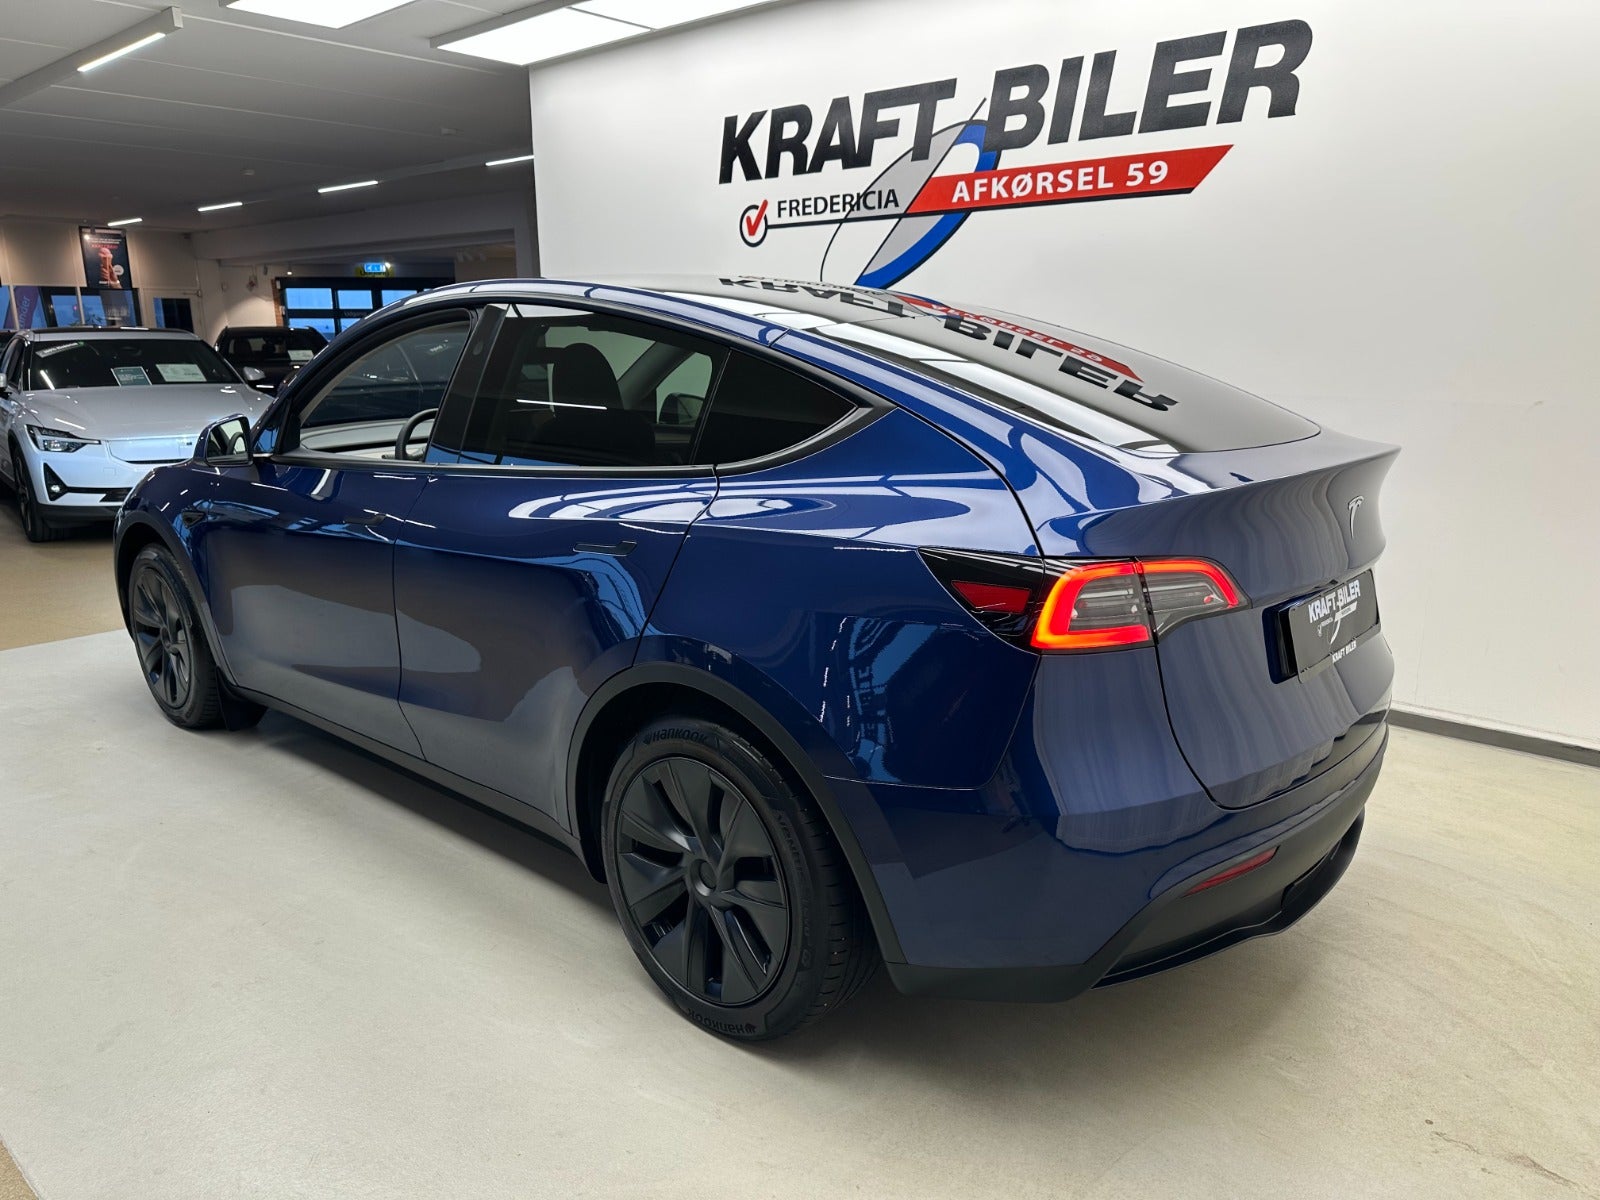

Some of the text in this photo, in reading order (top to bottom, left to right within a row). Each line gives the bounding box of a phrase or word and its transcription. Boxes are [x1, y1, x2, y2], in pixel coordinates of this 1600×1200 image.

[718, 19, 1313, 184] KRAFT BILER
[951, 160, 1169, 203] AFKØRSEL 59
[777, 188, 899, 219] FREDERICIA
[1308, 579, 1361, 623] KRAFT BILER
